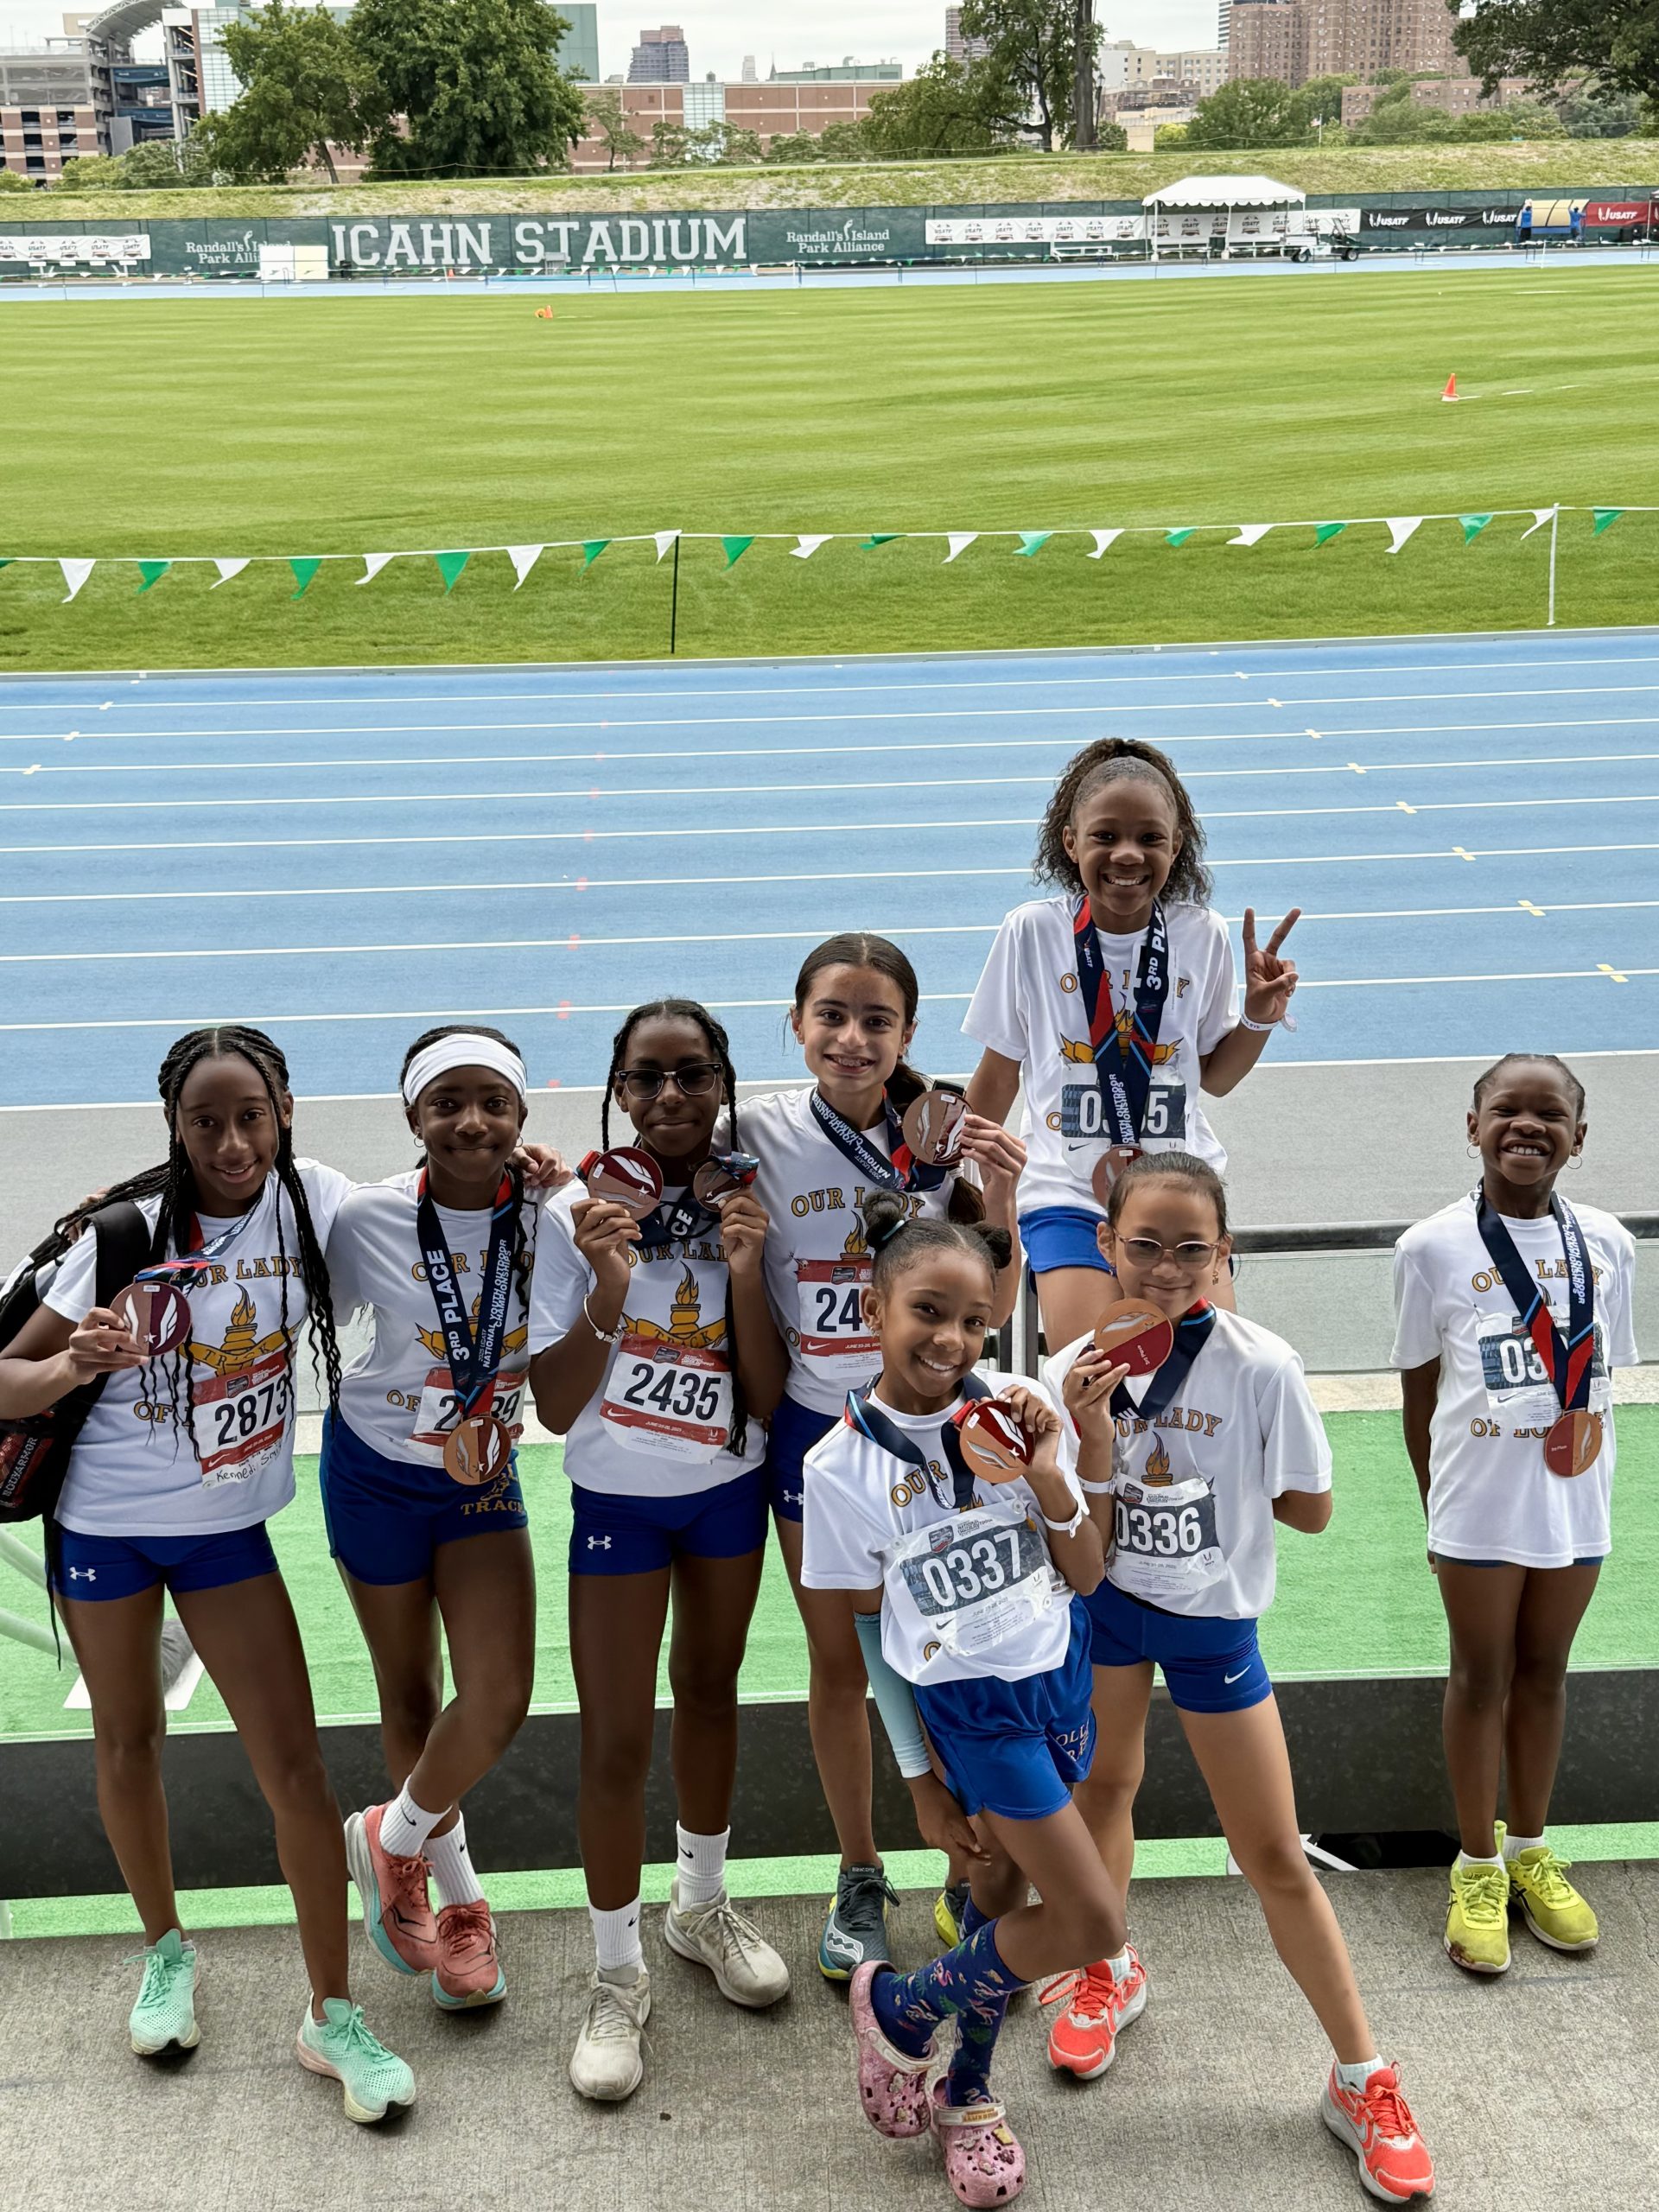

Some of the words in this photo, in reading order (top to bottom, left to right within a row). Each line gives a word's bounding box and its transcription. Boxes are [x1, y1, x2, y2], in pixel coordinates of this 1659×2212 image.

[1381, 217, 1409, 226] USATF
[1437, 216, 1465, 225] USATF
[1493, 214, 1517, 223] USAT
[185, 241, 245, 253] Randall's
[332, 222, 493, 267] ICAHN
[515, 218, 748, 264] STADIUM
[785, 230, 843, 243] Randall's
[851, 229, 891, 241] Island
[798, 242, 830, 254] Park
[832, 241, 886, 253] Alliance
[199, 253, 232, 264] Park
[234, 252, 261, 264] Alli
[1146, 957, 1162, 991] 3RD
[1079, 1090, 1169, 1135] 05
[854, 1145, 891, 1179] NATIONAL
[791, 1187, 846, 1217] OUR
[236, 1255, 303, 1279] LADY
[1471, 1266, 1506, 1293] OU
[426, 1249, 462, 1324] PLACE
[495, 1250, 512, 1328] CHAMPIONSHIPS
[816, 1287, 863, 1332] 24
[482, 1323, 496, 1368] NATIONAL
[489, 1287, 501, 1322] YOUTH
[448, 1331, 470, 1361] 3RD
[386, 1389, 422, 1413] OF
[623, 1363, 721, 1421] 2435
[133, 1401, 174, 1424] OF
[214, 1374, 288, 1447] 2873
[1154, 1407, 1224, 1438] LADY
[2, 1437, 39, 1497] BODYARMOR
[890, 1459, 949, 1508] OUR
[1116, 1499, 1203, 1555] 0336
[921, 1529, 1021, 1607] 0337
